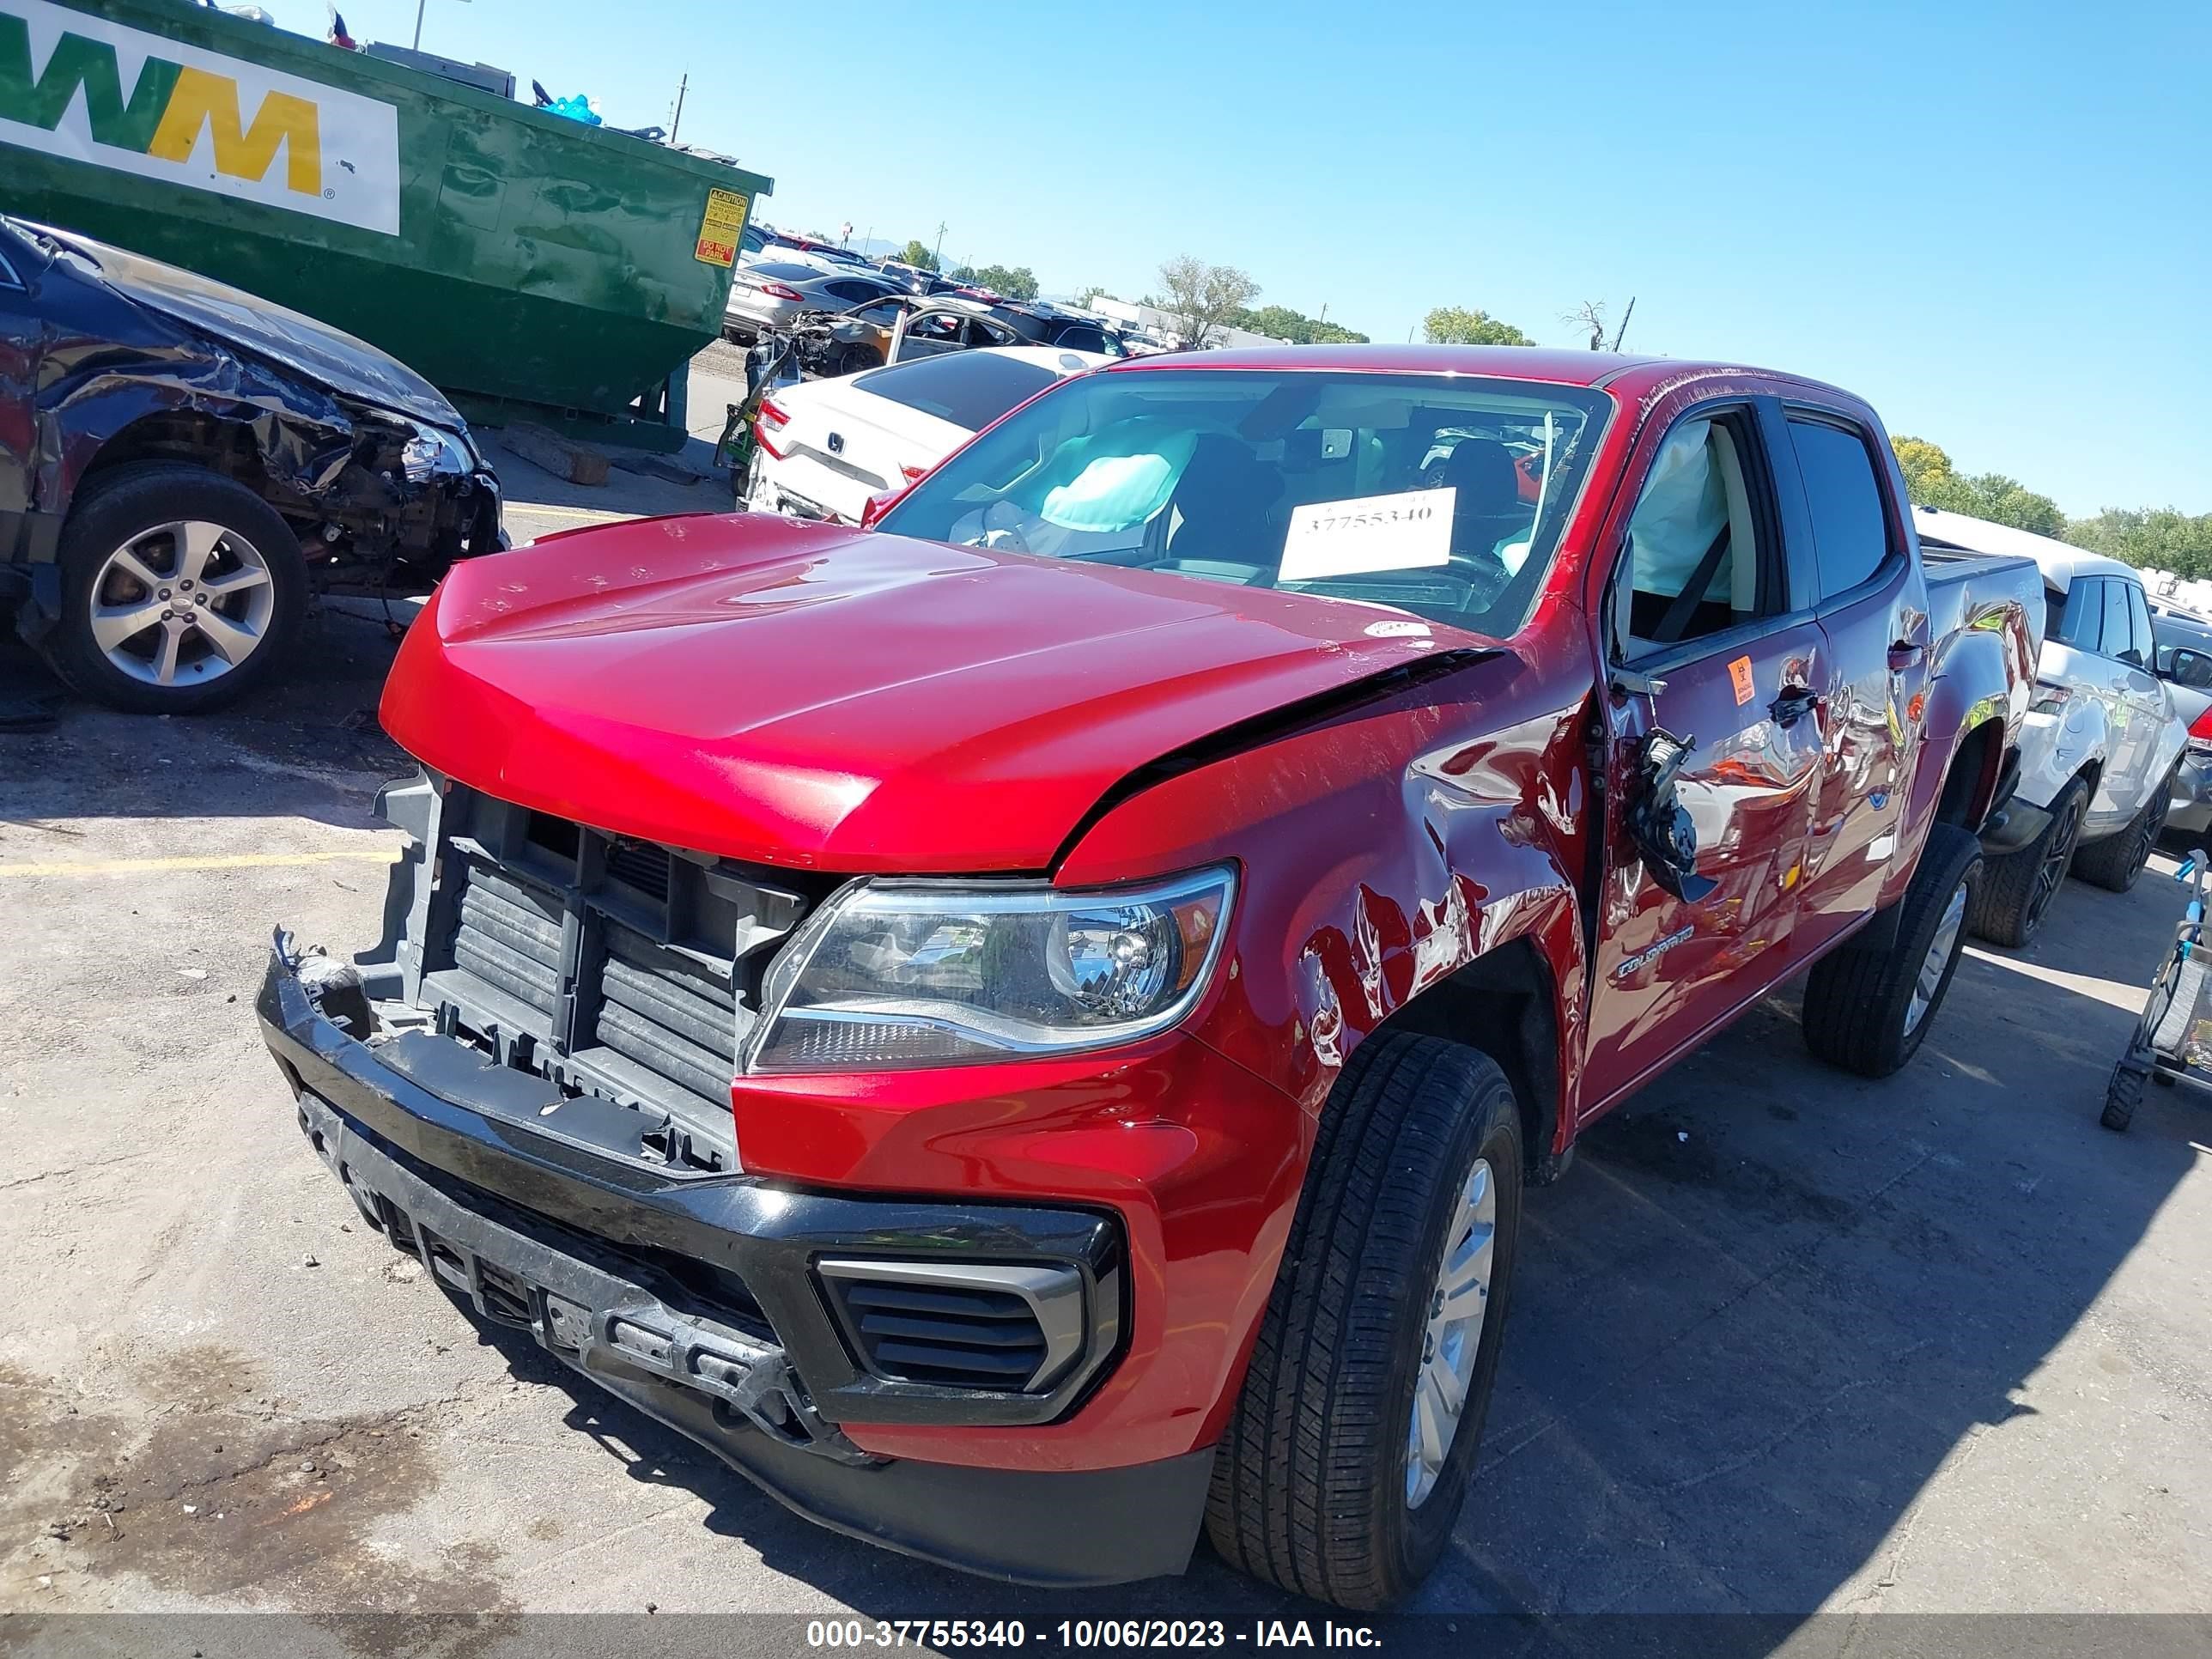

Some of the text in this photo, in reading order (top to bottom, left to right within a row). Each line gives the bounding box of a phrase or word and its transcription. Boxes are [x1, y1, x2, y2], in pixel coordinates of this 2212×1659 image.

[0, 11, 322, 197] WM
[717, 192, 746, 207] CAUTION
[703, 241, 731, 253] DO NOT
[705, 249, 725, 260] PARK
[1305, 507, 1432, 533] 37755340
[1618, 924, 1694, 978] COLORADO
